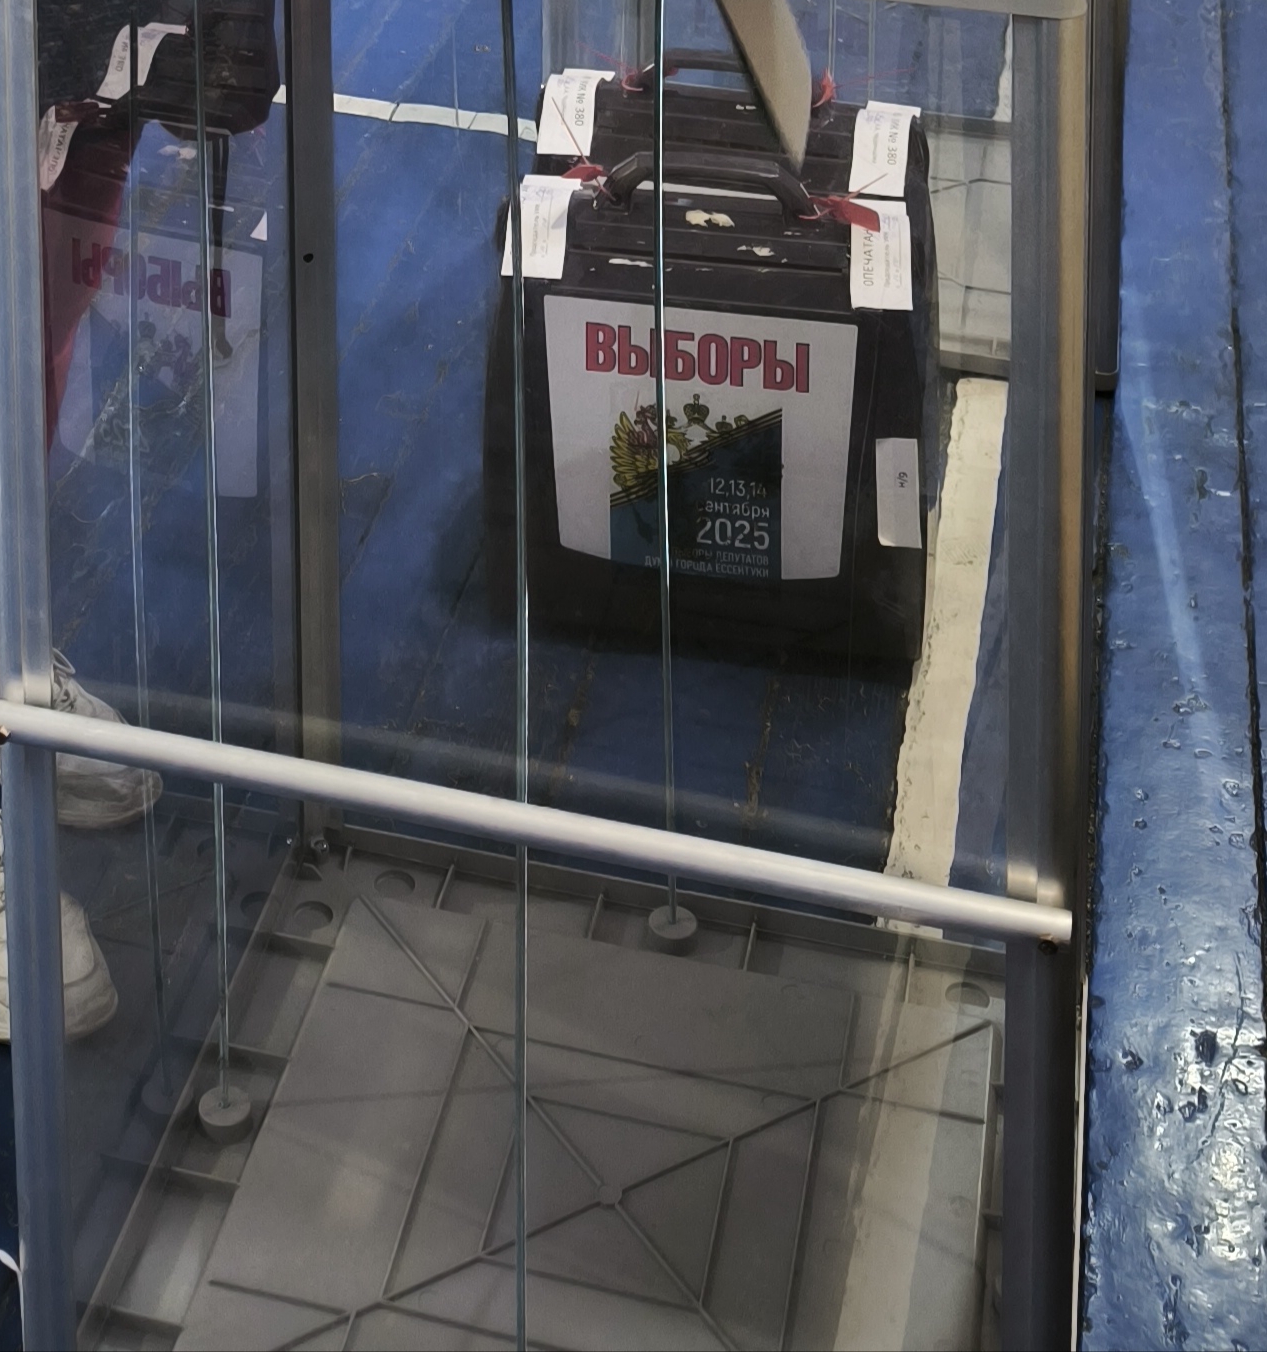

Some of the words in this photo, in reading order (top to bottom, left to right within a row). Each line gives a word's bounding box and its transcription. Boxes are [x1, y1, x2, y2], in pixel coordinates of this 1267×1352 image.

[585, 321, 810, 393] ВЫБОРЫ
[697, 499, 770, 520] ентября
[696, 516, 770, 550] 2025
